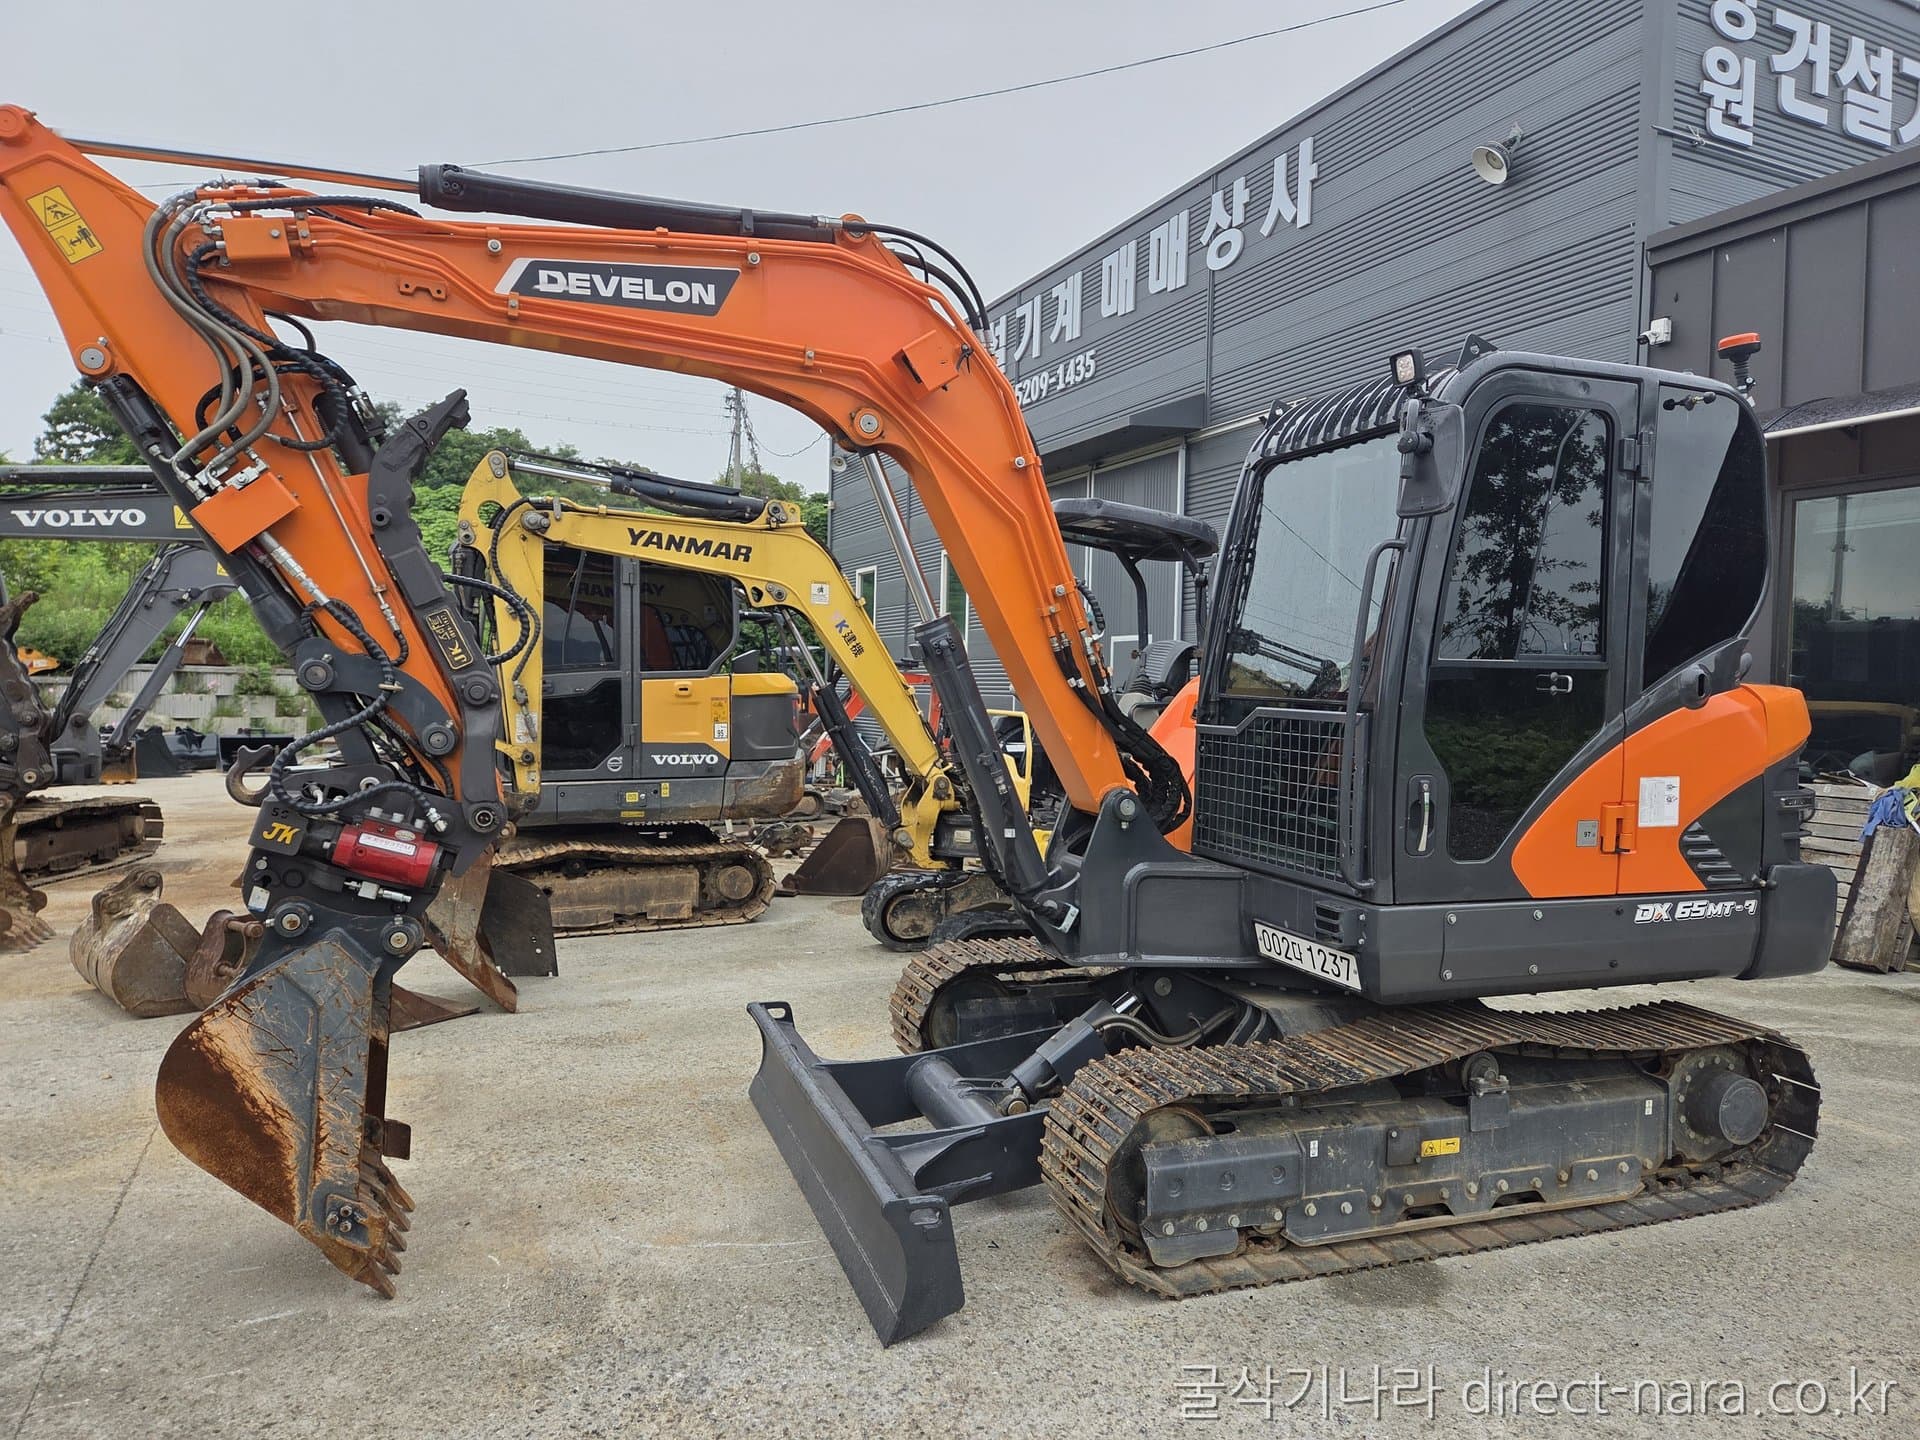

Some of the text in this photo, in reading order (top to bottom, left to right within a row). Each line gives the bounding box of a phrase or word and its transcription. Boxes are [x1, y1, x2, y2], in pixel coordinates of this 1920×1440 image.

[532, 269, 717, 306] DEVELON
[10, 508, 147, 528] VOLVO
[627, 527, 753, 563] YANMAR
[447, 640, 468, 663] JK
[651, 754, 719, 766] VOLVO
[262, 822, 301, 845] JK
[1633, 902, 1674, 925] DX
[1306, 944, 1351, 982] 1237
